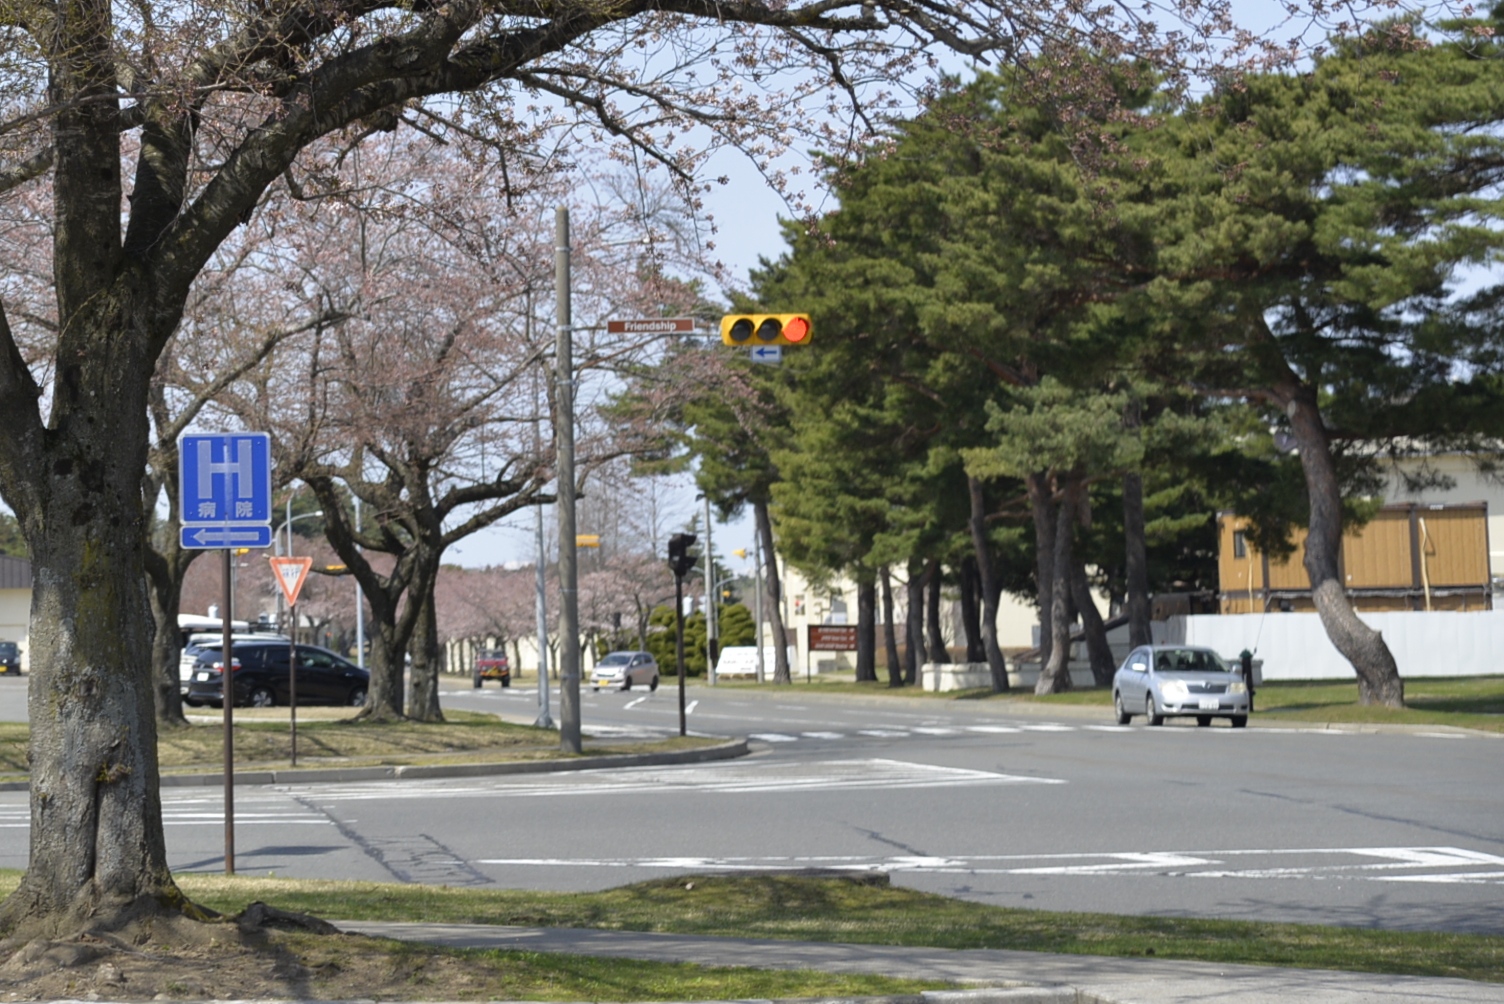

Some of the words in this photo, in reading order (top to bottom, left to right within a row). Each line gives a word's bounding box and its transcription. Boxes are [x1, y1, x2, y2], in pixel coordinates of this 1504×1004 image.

[624, 321, 676, 332] Friendship
[197, 439, 253, 499] H
[198, 501, 253, 518] 病院
